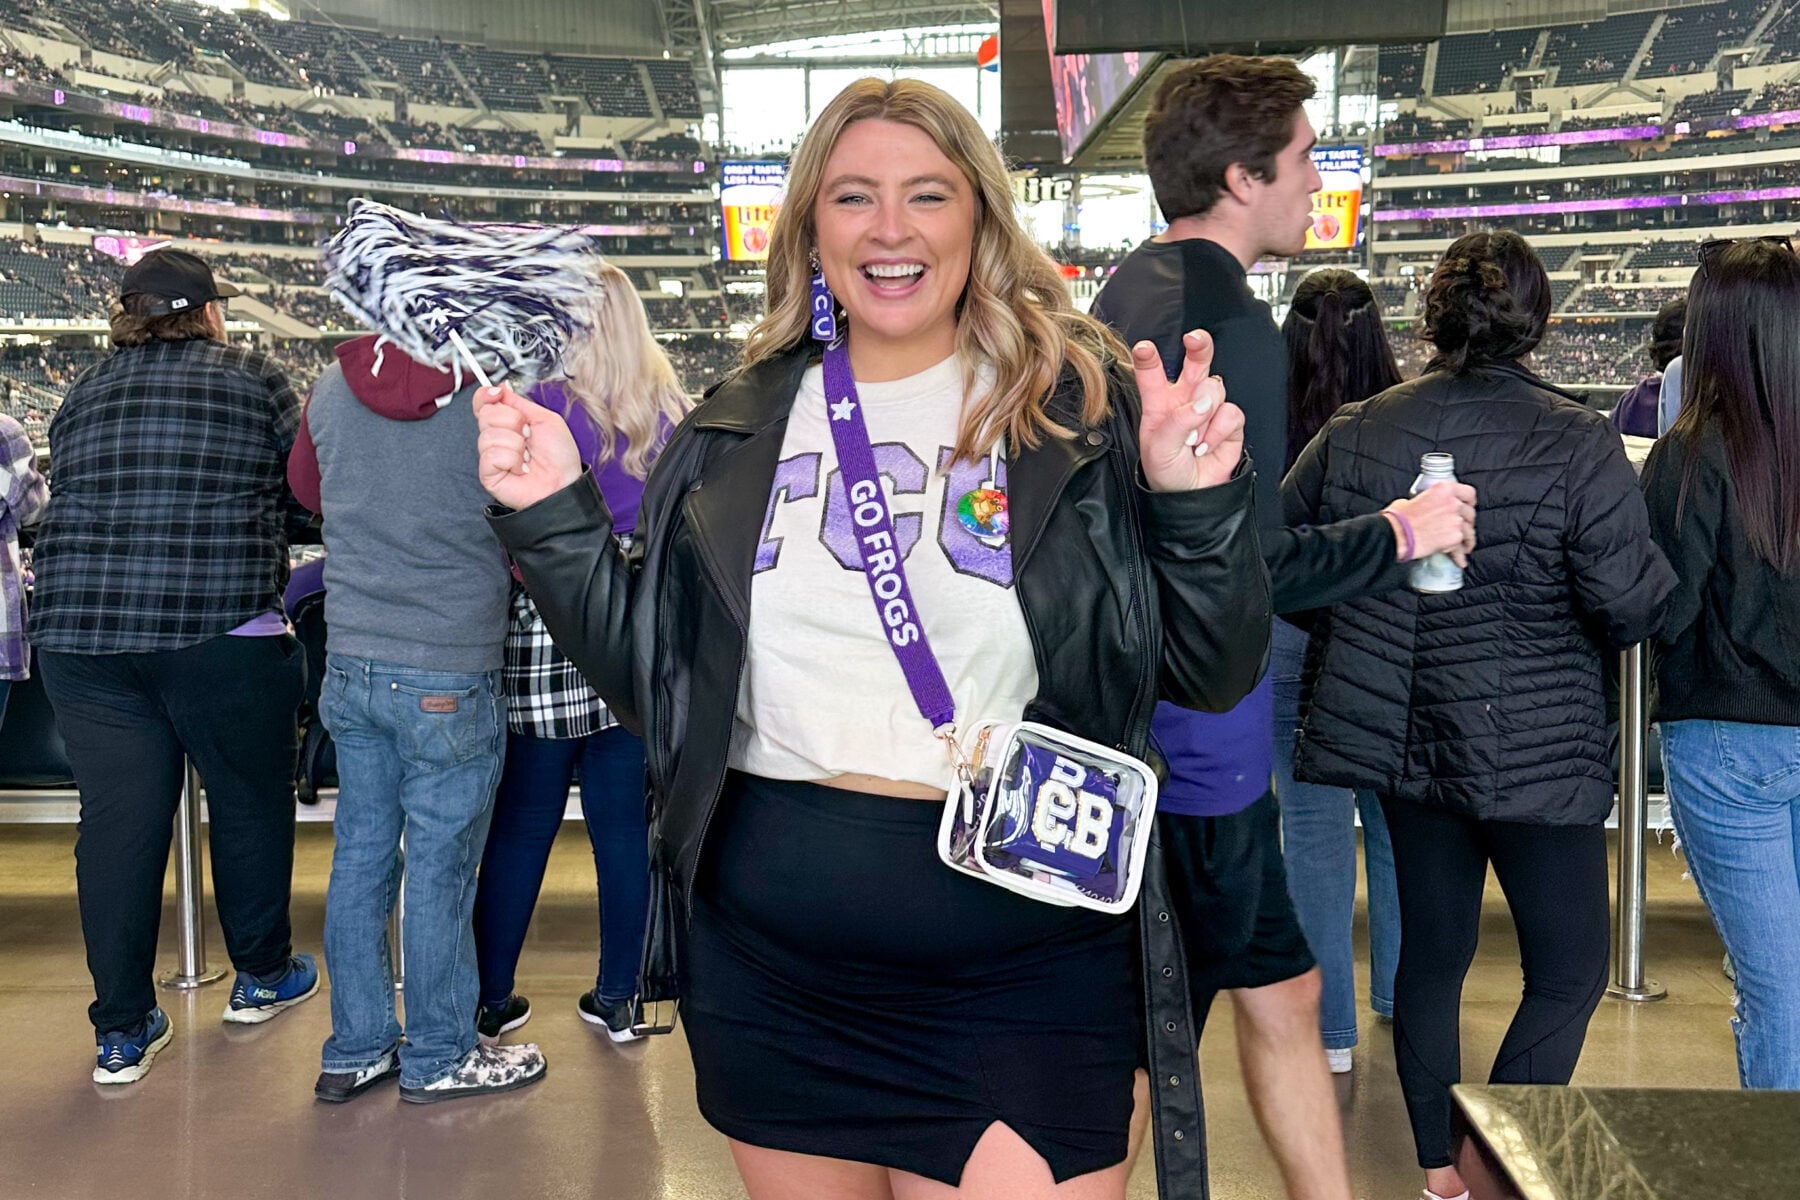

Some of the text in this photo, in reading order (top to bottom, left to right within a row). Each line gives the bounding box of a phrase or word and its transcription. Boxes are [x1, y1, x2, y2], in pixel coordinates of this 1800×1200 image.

[812, 271, 831, 336] TCU
[850, 479, 920, 647] GO FROGS
[1031, 779, 1114, 860] CB
